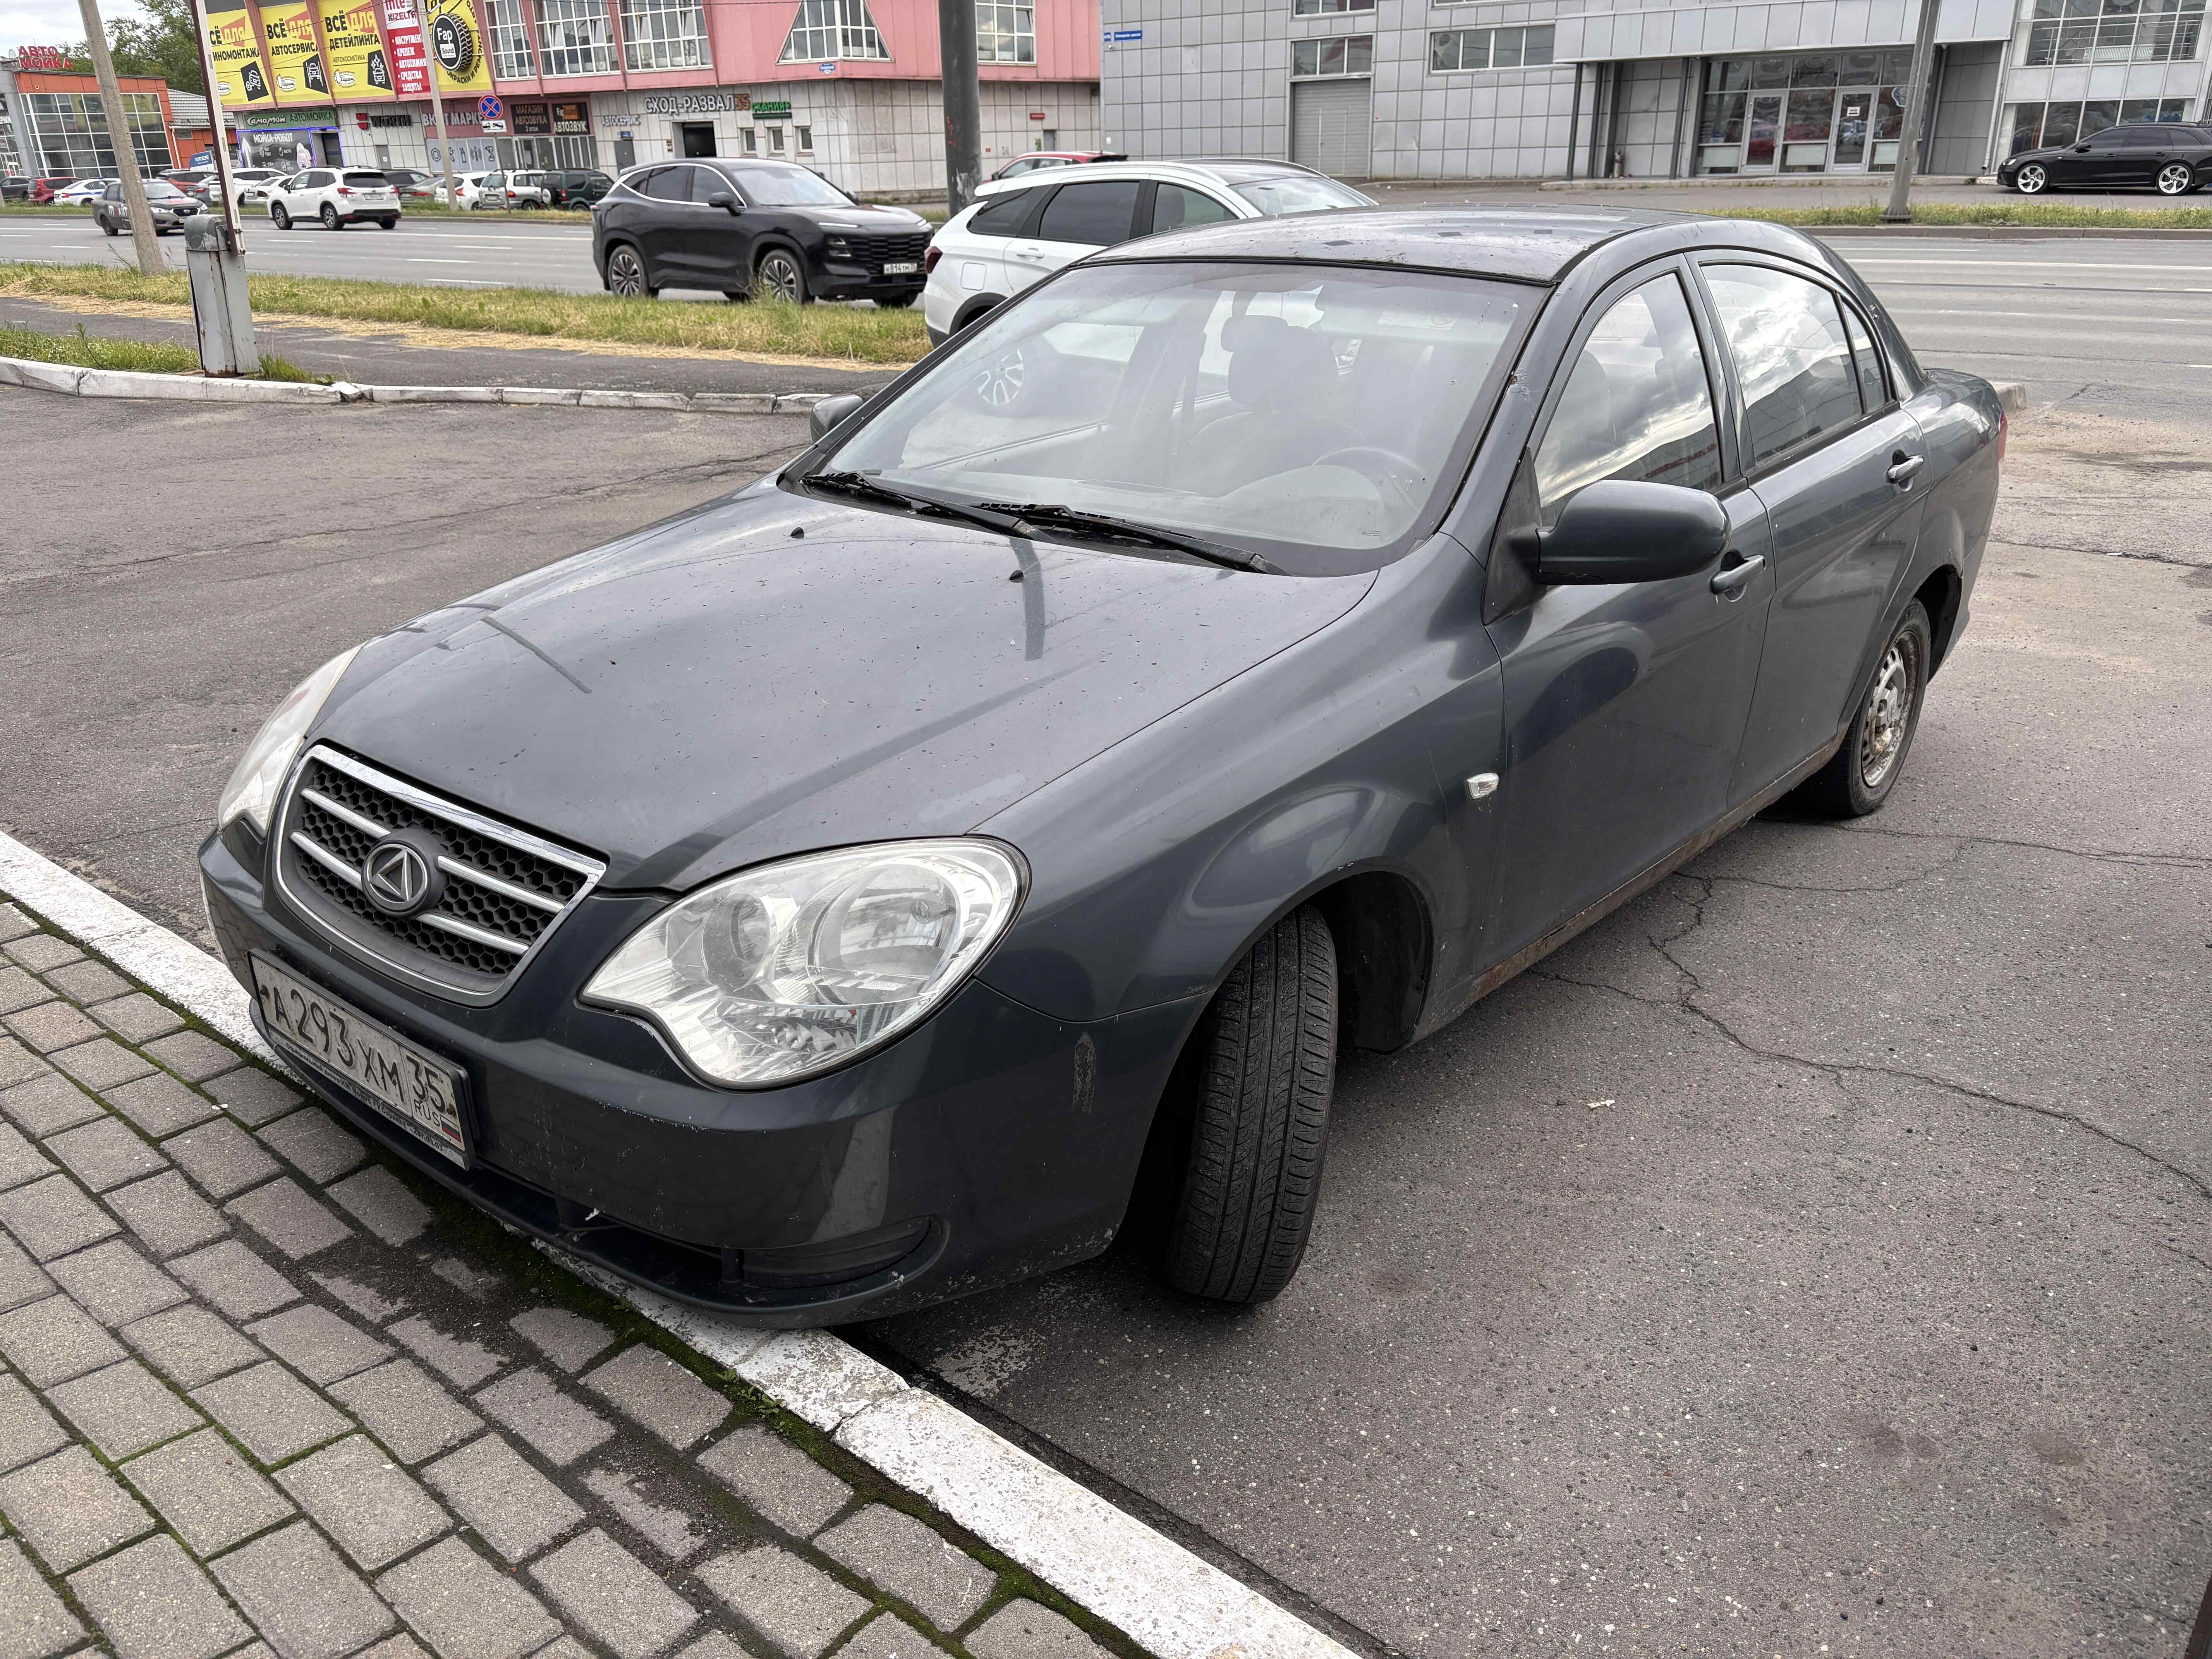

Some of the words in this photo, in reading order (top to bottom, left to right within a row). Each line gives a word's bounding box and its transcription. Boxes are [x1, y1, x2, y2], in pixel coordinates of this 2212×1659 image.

[325, 10, 348, 33] ВСЁ
[350, 11, 375, 32] ДЛЯ
[266, 18, 287, 40] ВСЁ
[289, 19, 311, 38] ДЛЯ
[210, 25, 222, 45] СЁ
[223, 27, 245, 43] ДЛЯ
[437, 28, 452, 44] Fap
[330, 34, 380, 51] ДЕТЕЙЛИНГА
[19, 46, 59, 57] АВТО
[213, 47, 260, 62] ИНОМОНТАЖ
[397, 47, 415, 57] КРЕПЕЖ
[333, 55, 366, 63] АВТОКОСМЕТИКА
[399, 58, 427, 68] АВТОХИМИЯ
[401, 70, 422, 81] СРЕДСТВА
[515, 105, 543, 113] МАГАЗИН
[515, 116, 548, 125] АВТОЗВУКА
[601, 115, 641, 127] АВТОСЕРВИС
[554, 121, 587, 132] АВТОЗВУК
[254, 132, 293, 143] МОЙКА-РОБОТ
[273, 986, 404, 1103] А293ХМ
[406, 1054, 446, 1112] 35
[414, 1099, 441, 1127] RUS
